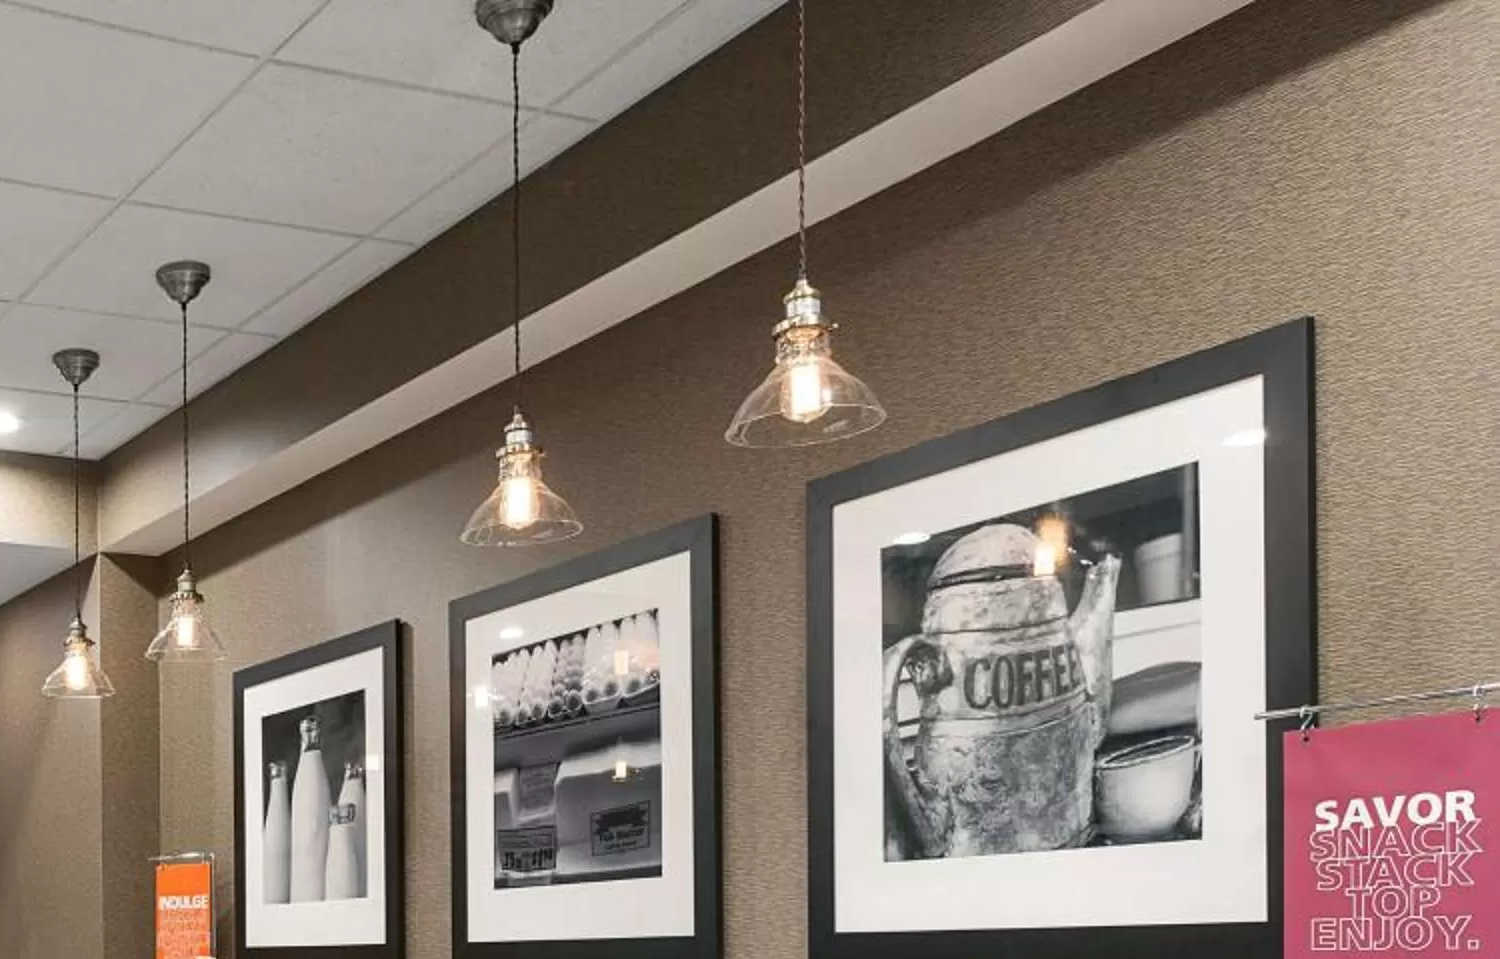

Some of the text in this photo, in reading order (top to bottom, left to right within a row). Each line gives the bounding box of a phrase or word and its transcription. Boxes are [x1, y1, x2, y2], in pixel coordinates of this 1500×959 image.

[963, 643, 1079, 710] COFFEE
[1314, 789, 1476, 832] SAVOR
[1308, 818, 1483, 863] SNACK
[1315, 851, 1475, 890] STACK
[1345, 884, 1441, 920] TOP
[1310, 914, 1480, 951] ENJOY.
